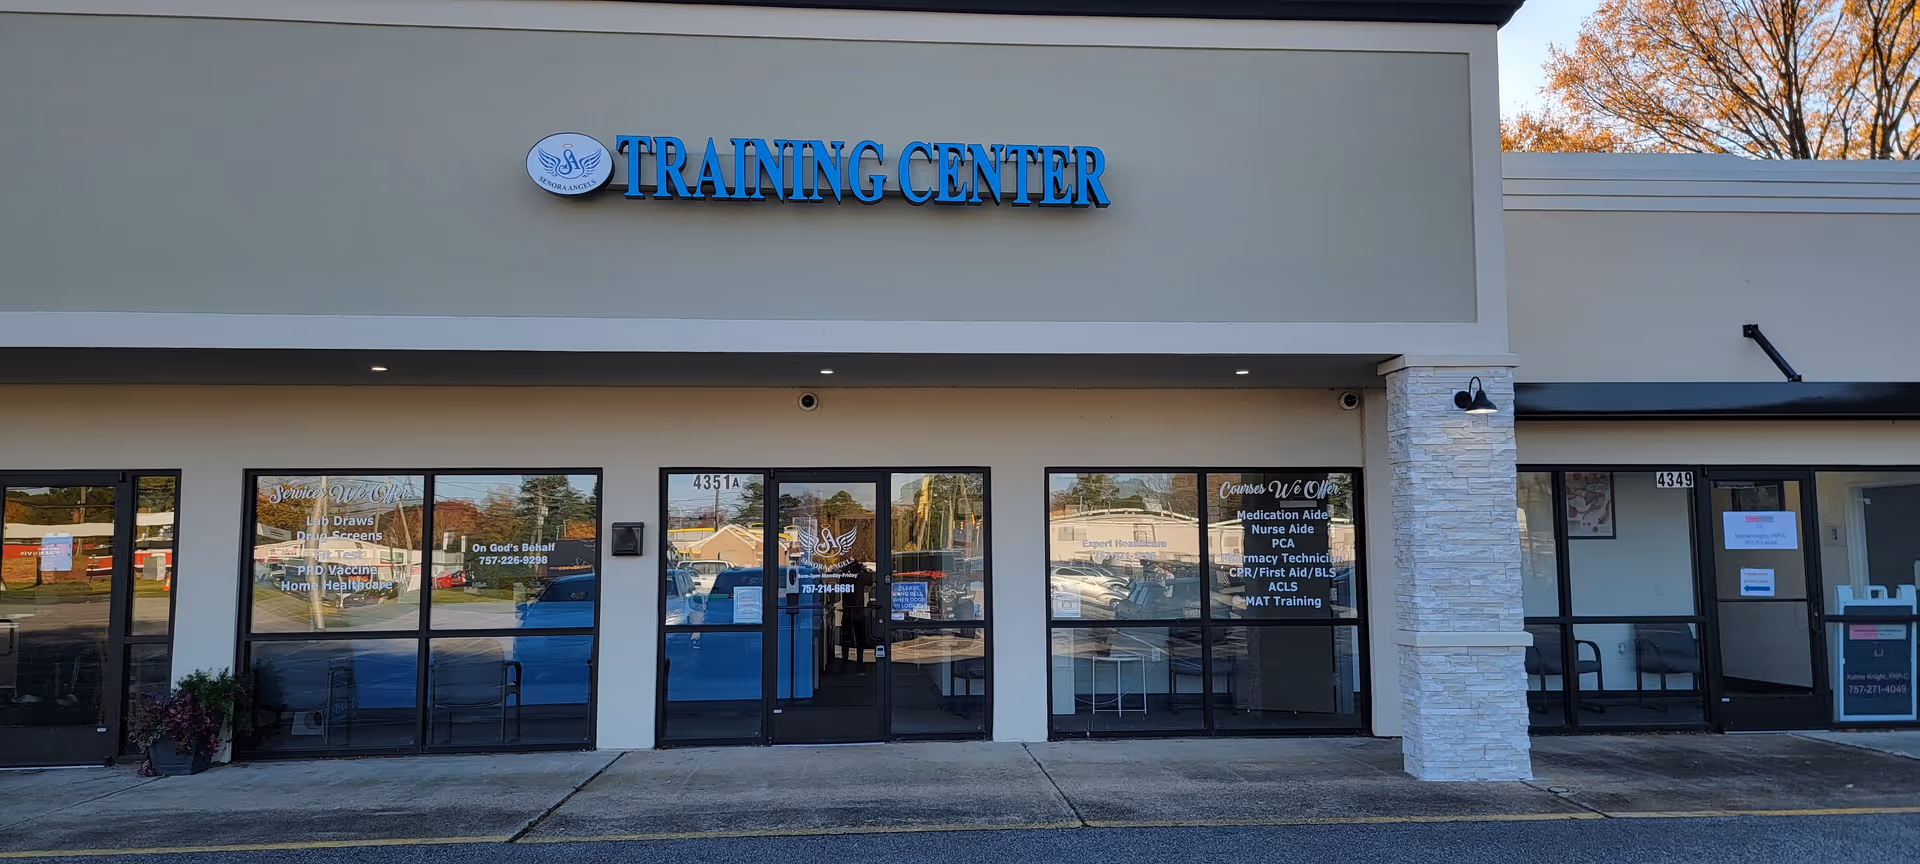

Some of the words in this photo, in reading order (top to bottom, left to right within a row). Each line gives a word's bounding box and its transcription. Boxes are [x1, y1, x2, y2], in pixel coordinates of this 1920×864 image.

[616, 135, 888, 204] TRAINING
[900, 141, 1111, 207] CENTER
[538, 176, 567, 191] SENORA
[567, 178, 597, 191] ANGELS
[1657, 472, 1693, 487] 4349
[269, 480, 327, 504] Services
[330, 482, 368, 504] We
[1219, 481, 1267, 499] Courses
[1268, 479, 1302, 499] We
[1236, 509, 1299, 520] Medication
[1302, 509, 1329, 520] Aide
[306, 515, 329, 526] Lab
[333, 515, 374, 526] Draws
[1251, 524, 1285, 534] Nurse
[1288, 523, 1315, 534] Aide
[296, 530, 328, 543] Drug
[332, 530, 383, 541] Screens
[472, 543, 487, 552] On
[489, 543, 519, 552] God's
[521, 542, 556, 552] Behalf
[1082, 540, 1113, 549] Expert
[1271, 538, 1296, 549] PCA
[335, 549, 363, 560] Test
[1281, 552, 1344, 563] Technician
[479, 556, 548, 565] 757-226-9298
[829, 555, 856, 570] ANGELS
[297, 565, 324, 576] PPD
[328, 564, 378, 576] Vaccine
[1229, 567, 1286, 580] CPR/First
[1288, 567, 1337, 580] Aid/BLS
[281, 580, 319, 591] Home
[323, 579, 393, 591] Healthcare
[801, 583, 855, 594] 757-214-6681
[1268, 581, 1299, 592] ACLS
[1245, 596, 1271, 606] MAT
[1273, 596, 1322, 608] Training
[1848, 684, 1907, 694] 757-271-4049
